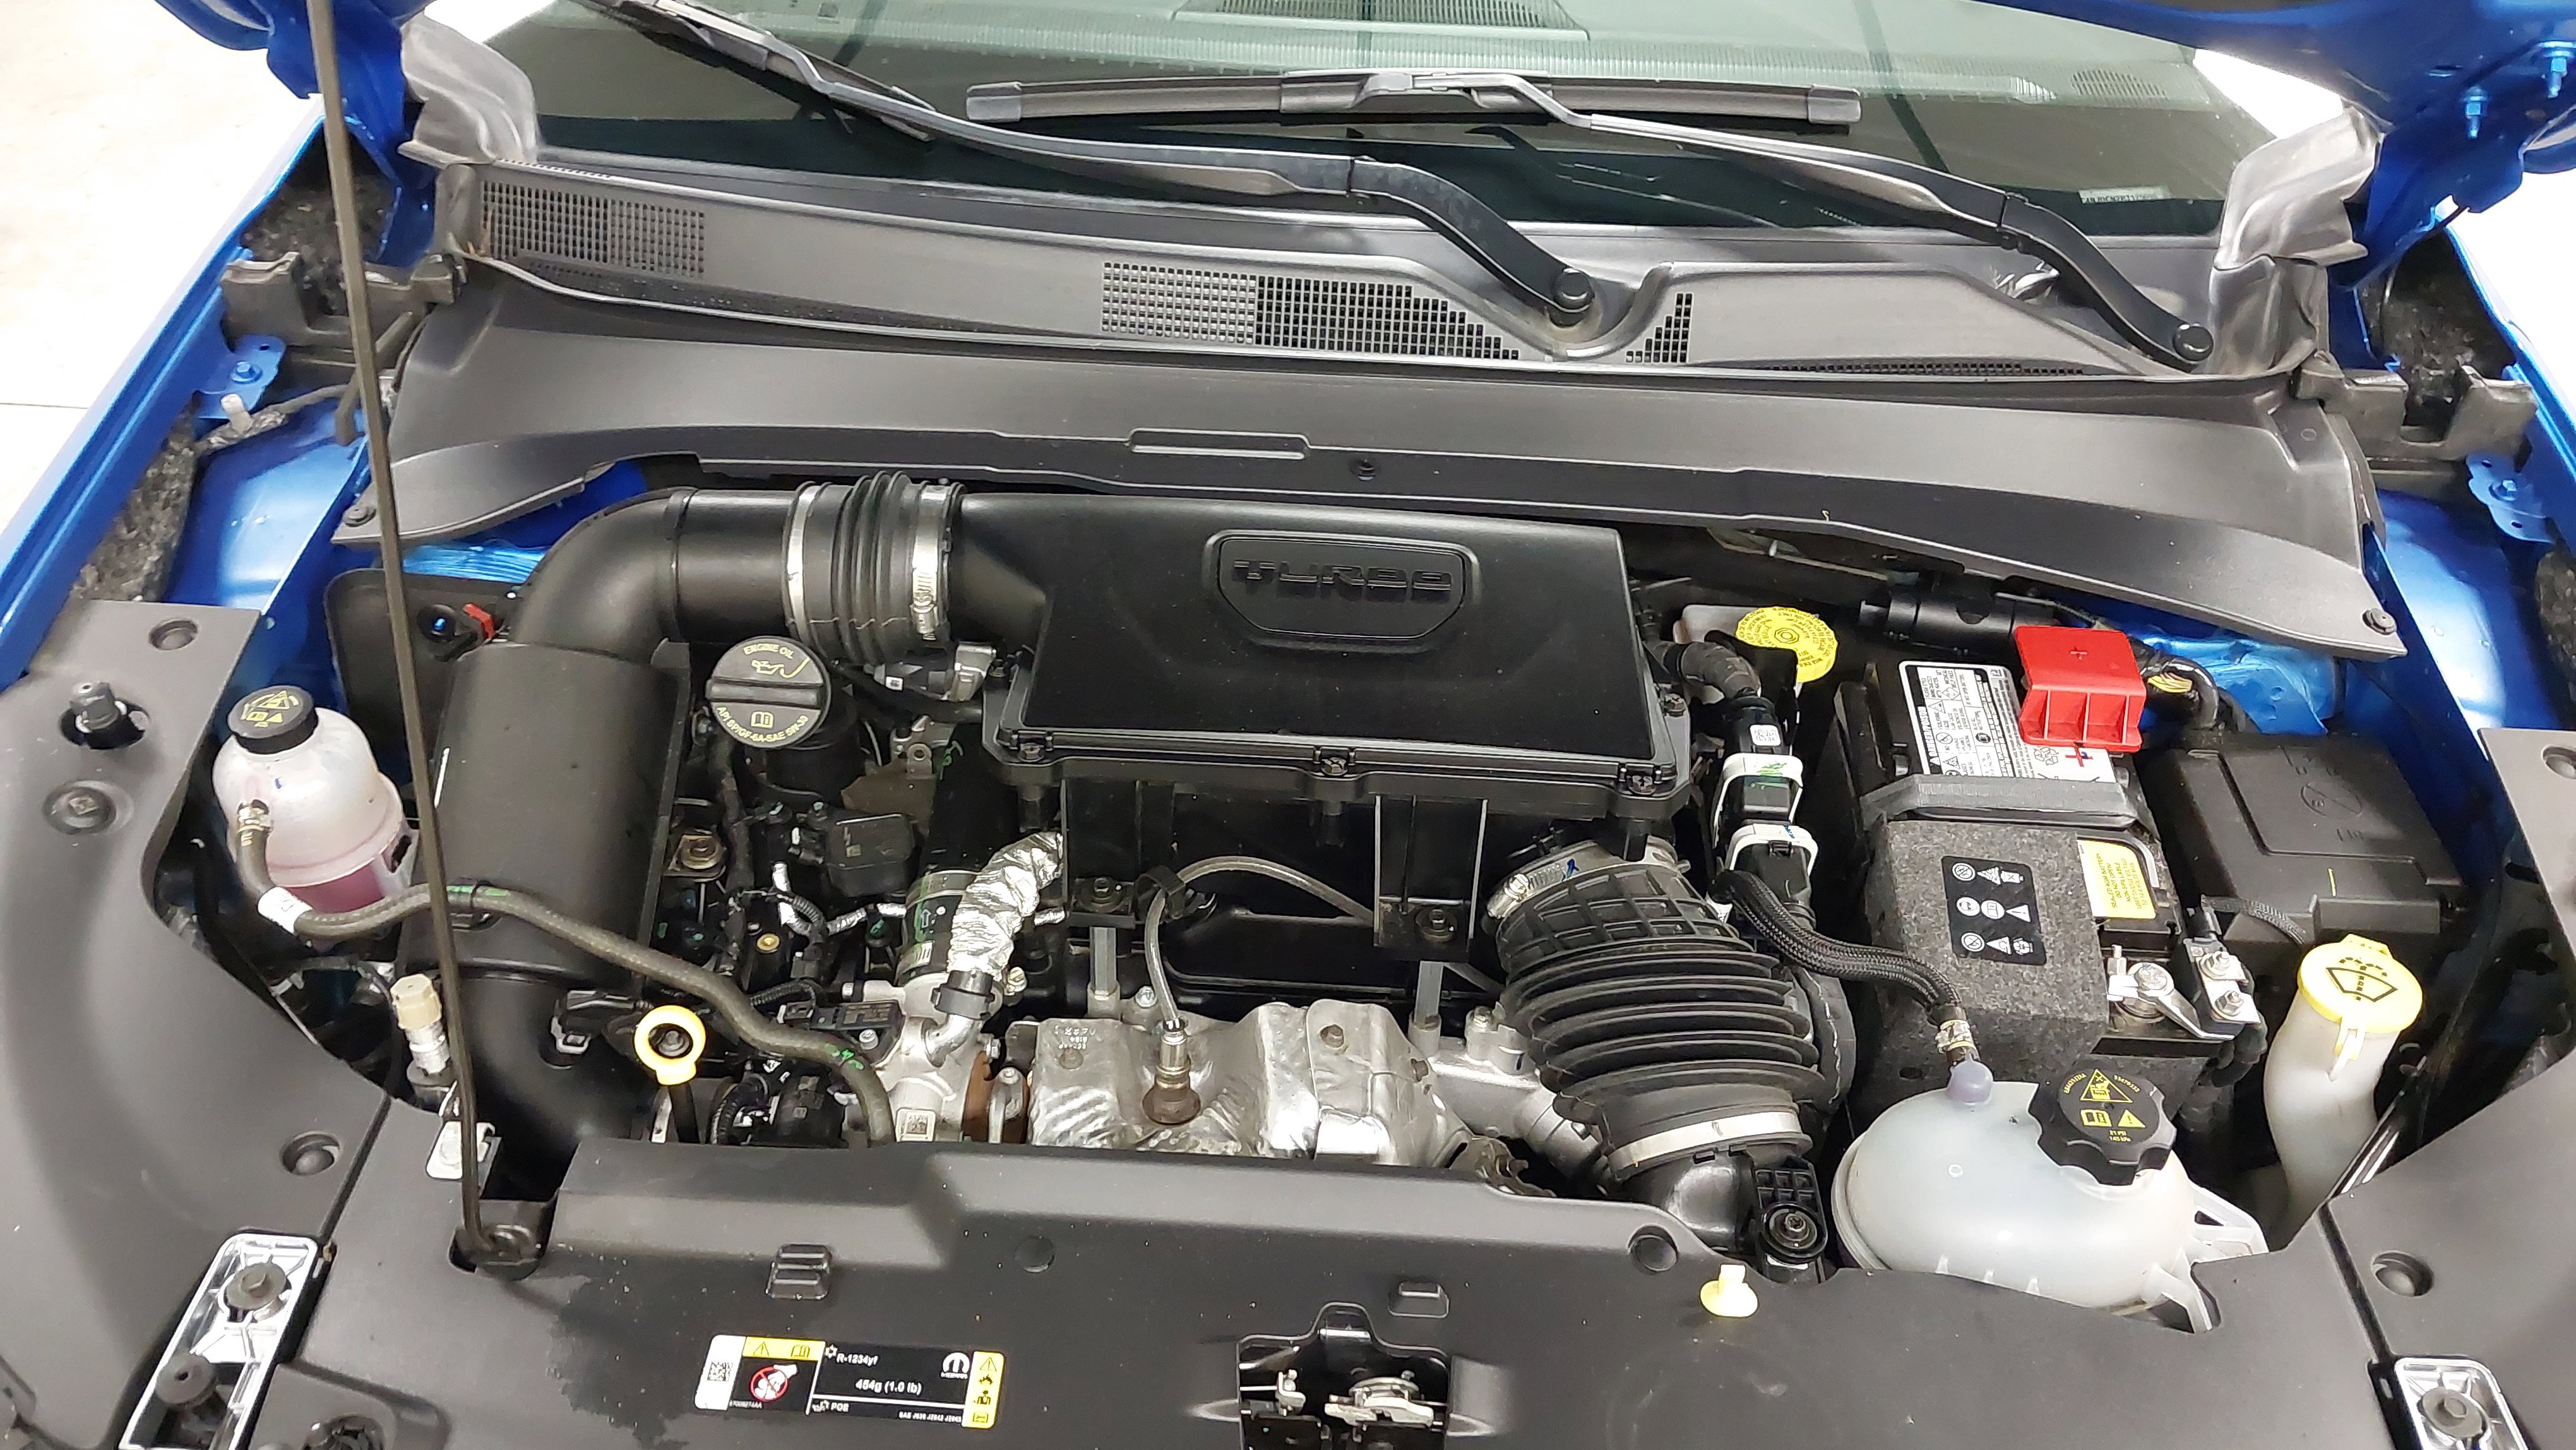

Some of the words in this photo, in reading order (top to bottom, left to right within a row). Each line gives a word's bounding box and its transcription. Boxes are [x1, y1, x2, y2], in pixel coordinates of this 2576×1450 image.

[1233, 560, 1451, 591] TURBO
[743, 644, 780, 655] ENGINE
[780, 647, 794, 659] OIL
[717, 707, 732, 721] API
[836, 1353, 878, 1367] R-1234yf
[885, 1380, 904, 1394] (1.0
[907, 1381, 922, 1396] lb)
